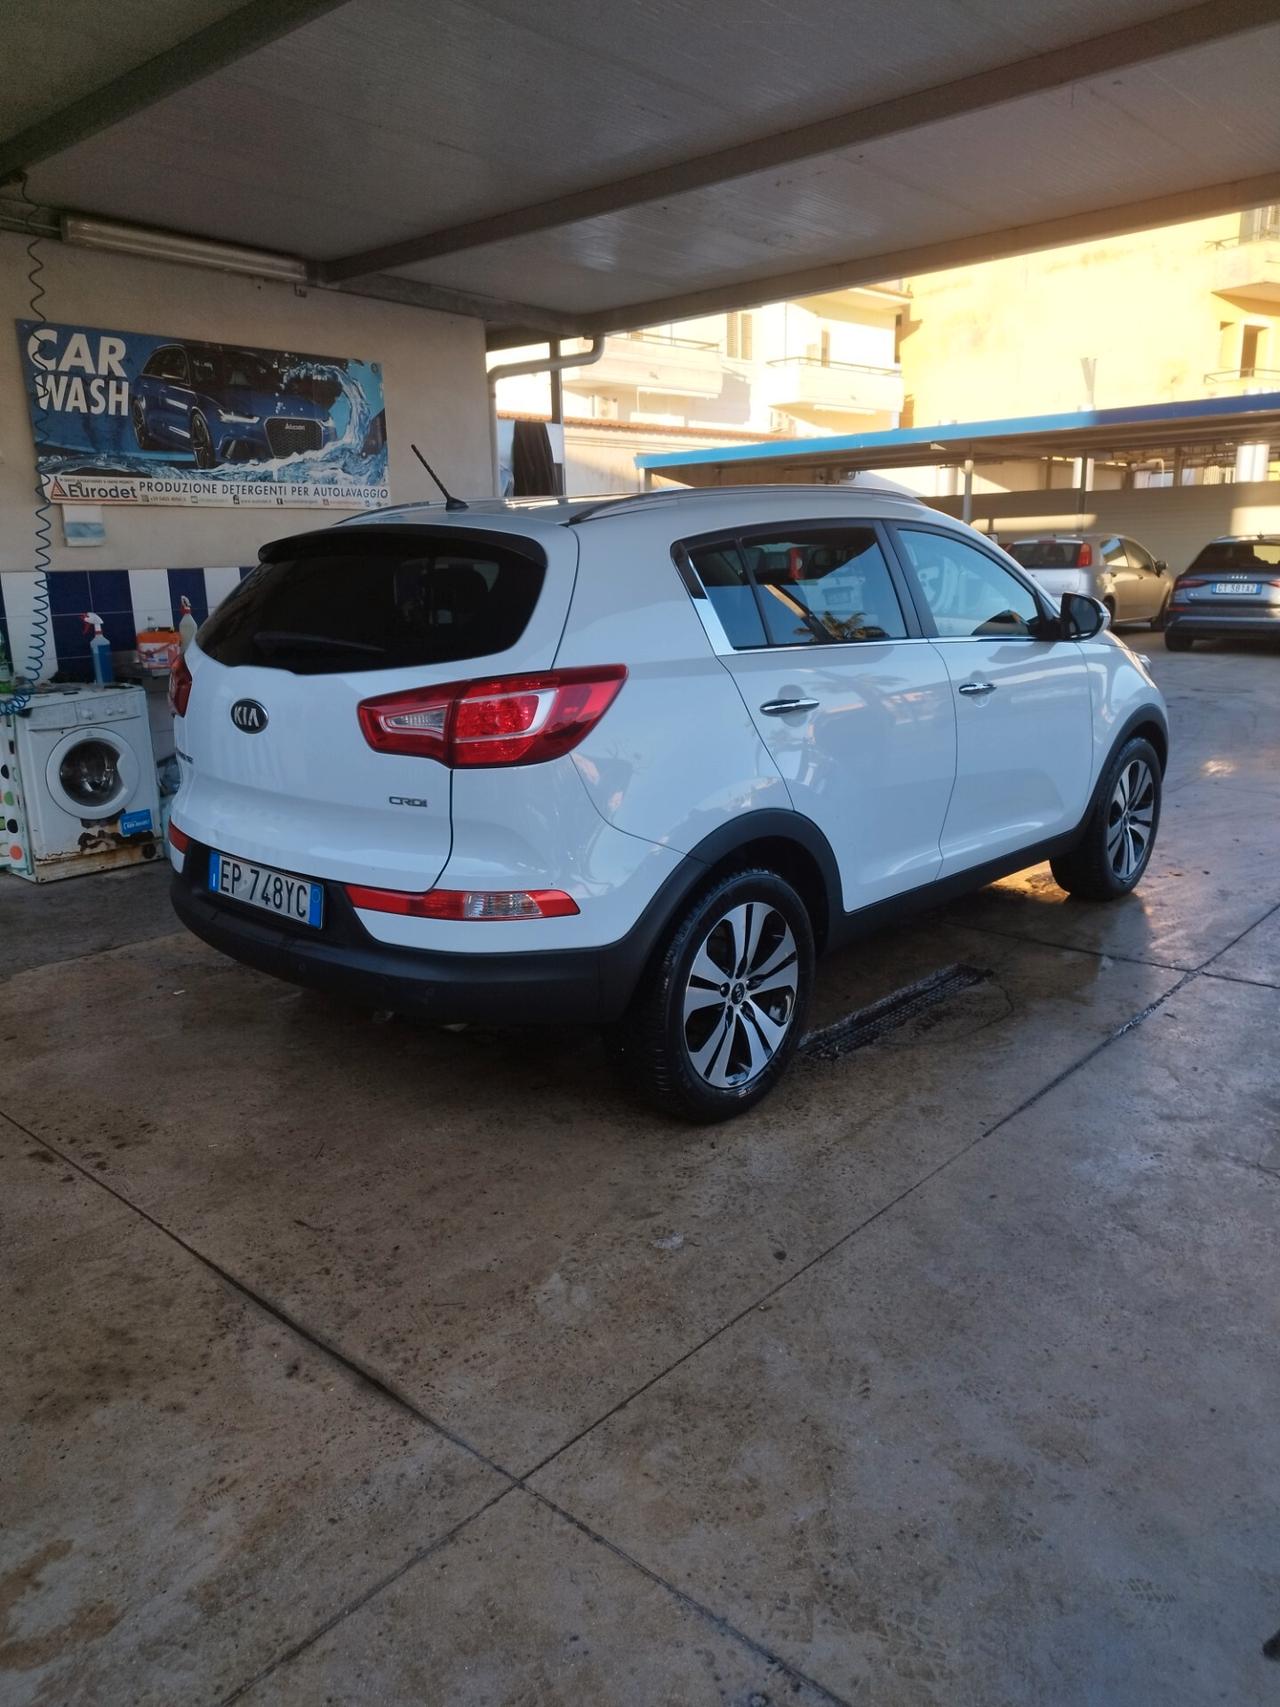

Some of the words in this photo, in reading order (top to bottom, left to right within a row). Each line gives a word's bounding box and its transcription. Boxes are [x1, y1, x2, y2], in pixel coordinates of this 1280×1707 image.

[27, 328, 128, 378] CAR
[34, 374, 129, 417] WASH
[139, 481, 217, 494] PRODUZIONE
[221, 484, 287, 496] DETERGENTI
[291, 487, 309, 497] PER
[313, 487, 389, 499] AUTOLAVAGGIO
[233, 706, 260, 728] KIA
[220, 860, 242, 894] EP
[249, 868, 307, 918] 748YC
